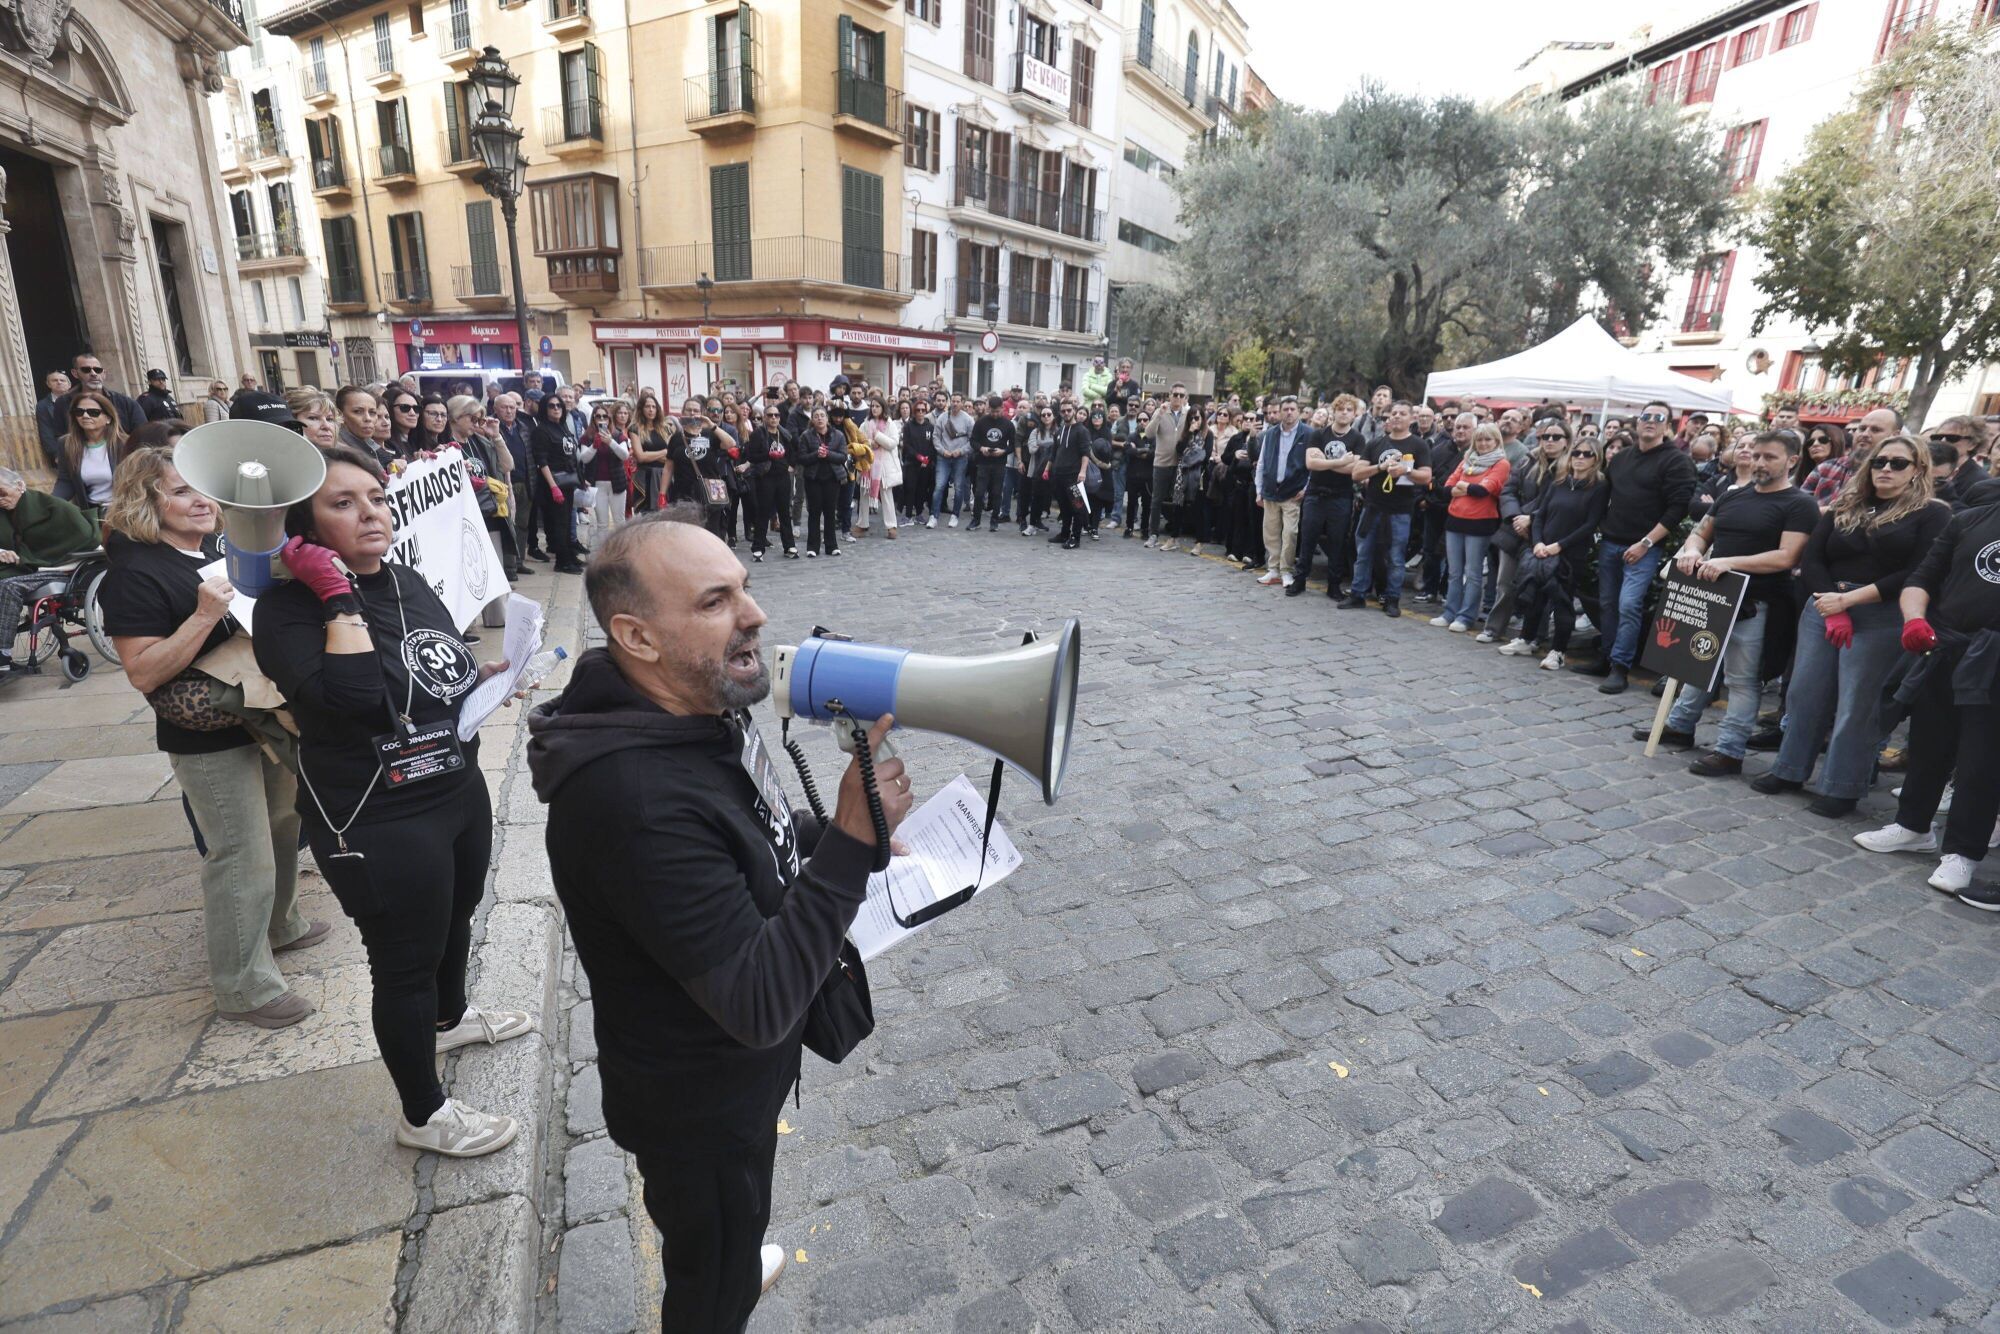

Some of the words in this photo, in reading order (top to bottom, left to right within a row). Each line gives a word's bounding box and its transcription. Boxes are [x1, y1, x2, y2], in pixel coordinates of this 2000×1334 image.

[1026, 59, 1038, 82] SE
[1040, 66, 1068, 96] VENDE
[655, 329, 691, 338] PASTISSERIA
[841, 331, 882, 343] PASTISSERIA
[884, 336, 901, 346] CORT
[1807, 401, 1850, 417] CORT
[1667, 580, 1680, 591] SIN
[1680, 584, 1732, 607] AUTÓNOMOS...
[1668, 592, 1676, 600] NI
[1676, 593, 1708, 611] NÓMINAS,
[1663, 609, 1671, 617] NI
[1671, 611, 1707, 629] IMPUESTOS
[1665, 600, 1673, 608] NI
[1673, 603, 1708, 620] EMPRESAS,
[1697, 637, 1712, 651] 30
[421, 642, 457, 670] 30
[444, 665, 460, 681] N
[382, 729, 451, 751] COODINADORA
[407, 765, 445, 779] MALLORCA
[985, 842, 1001, 865] FICIAL
